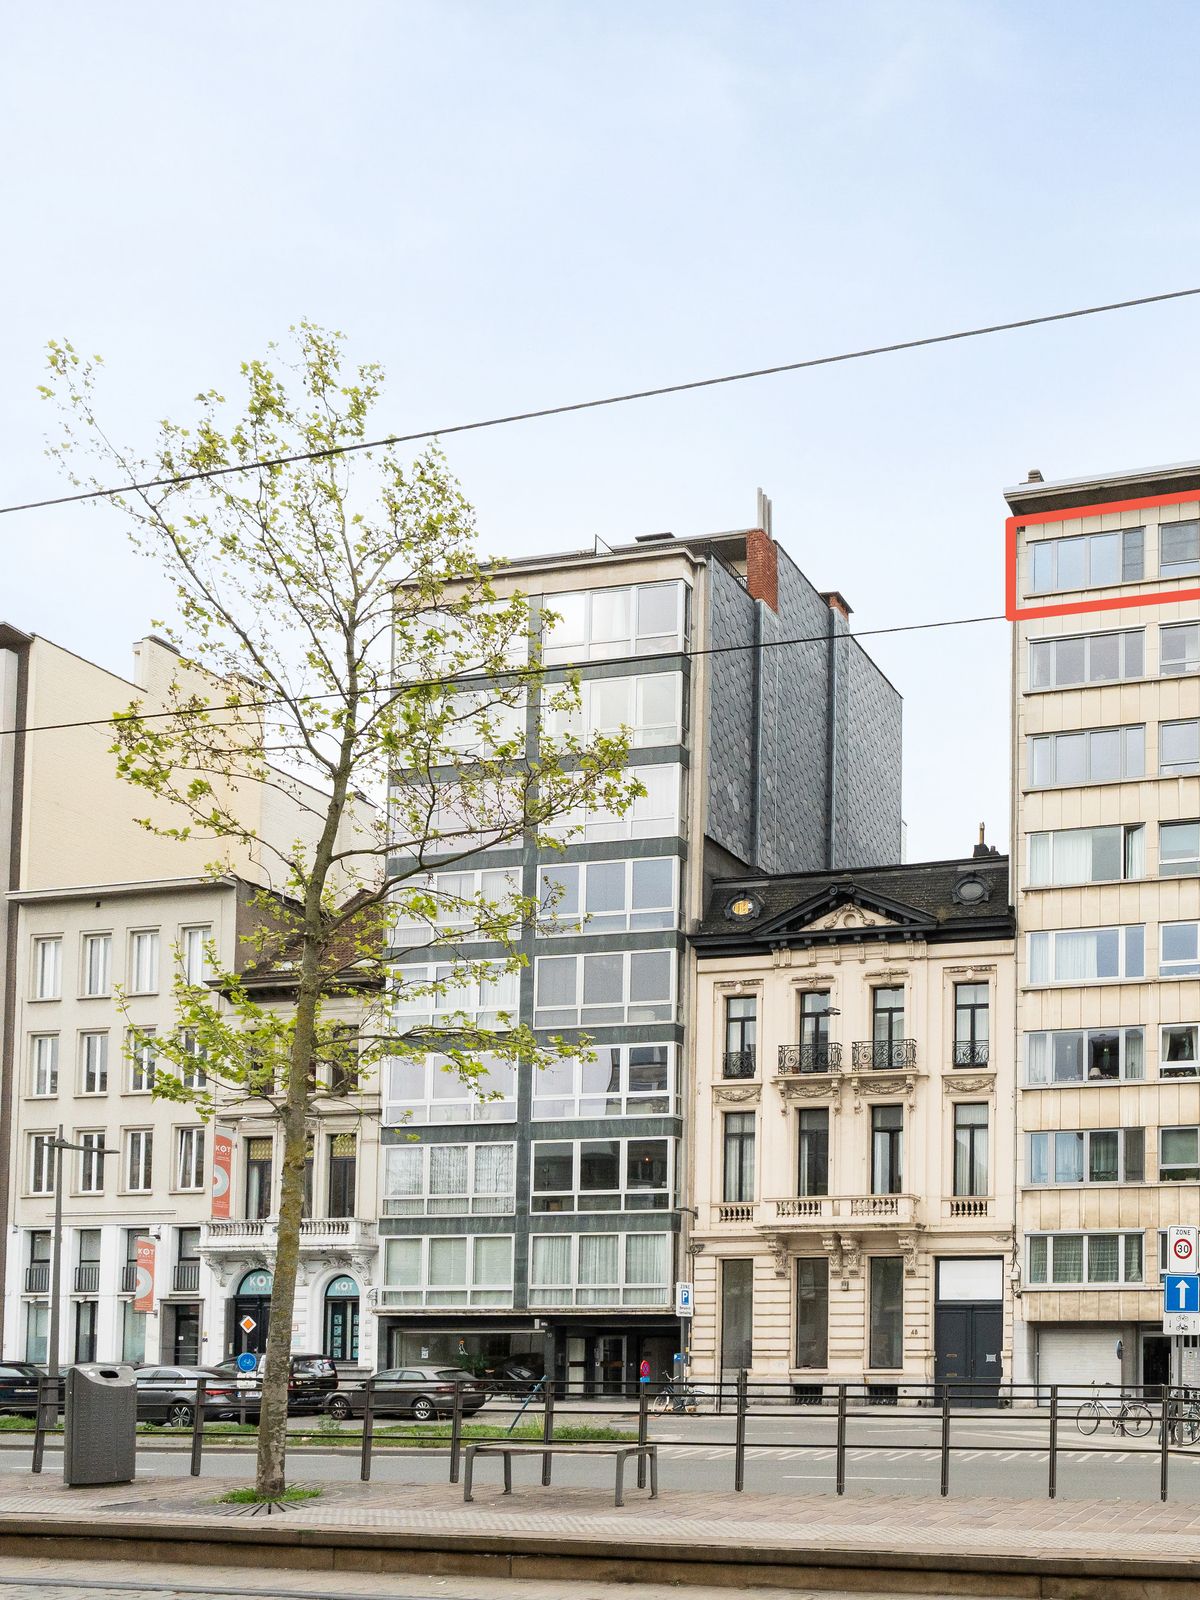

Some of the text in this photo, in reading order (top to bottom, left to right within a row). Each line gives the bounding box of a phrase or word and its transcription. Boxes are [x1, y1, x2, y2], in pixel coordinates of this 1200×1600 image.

[215, 1145, 231, 1153] KOT
[1177, 1244, 1189, 1253] 30
[249, 1275, 273, 1286] KOT
[335, 1281, 354, 1290] KOT
